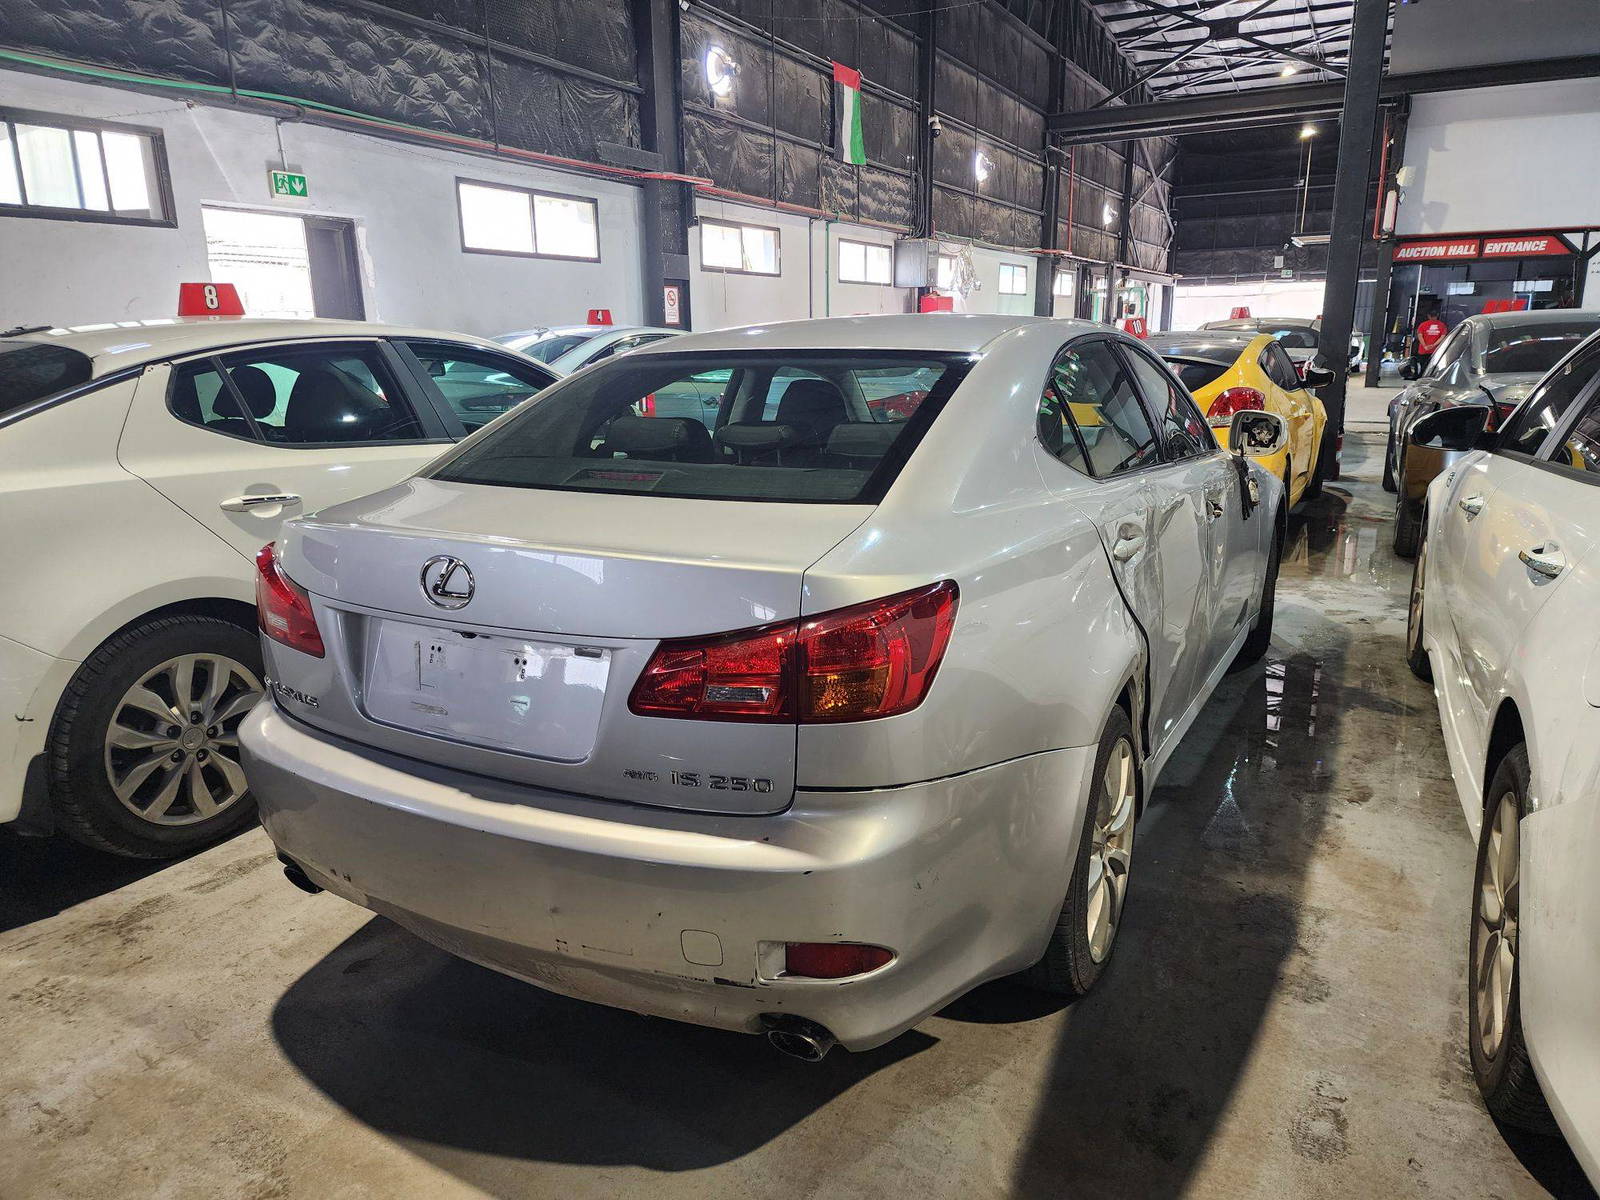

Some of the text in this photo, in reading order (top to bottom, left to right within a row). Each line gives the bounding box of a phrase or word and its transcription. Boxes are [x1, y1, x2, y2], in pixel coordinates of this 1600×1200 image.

[1397, 240, 1548, 258] AUCTION HALL ENTRANCE
[203, 284, 219, 310] 8
[1132, 319, 1143, 334] 10
[275, 681, 319, 709] LEXUS
[670, 770, 700, 787] IS
[709, 775, 775, 793] 250
